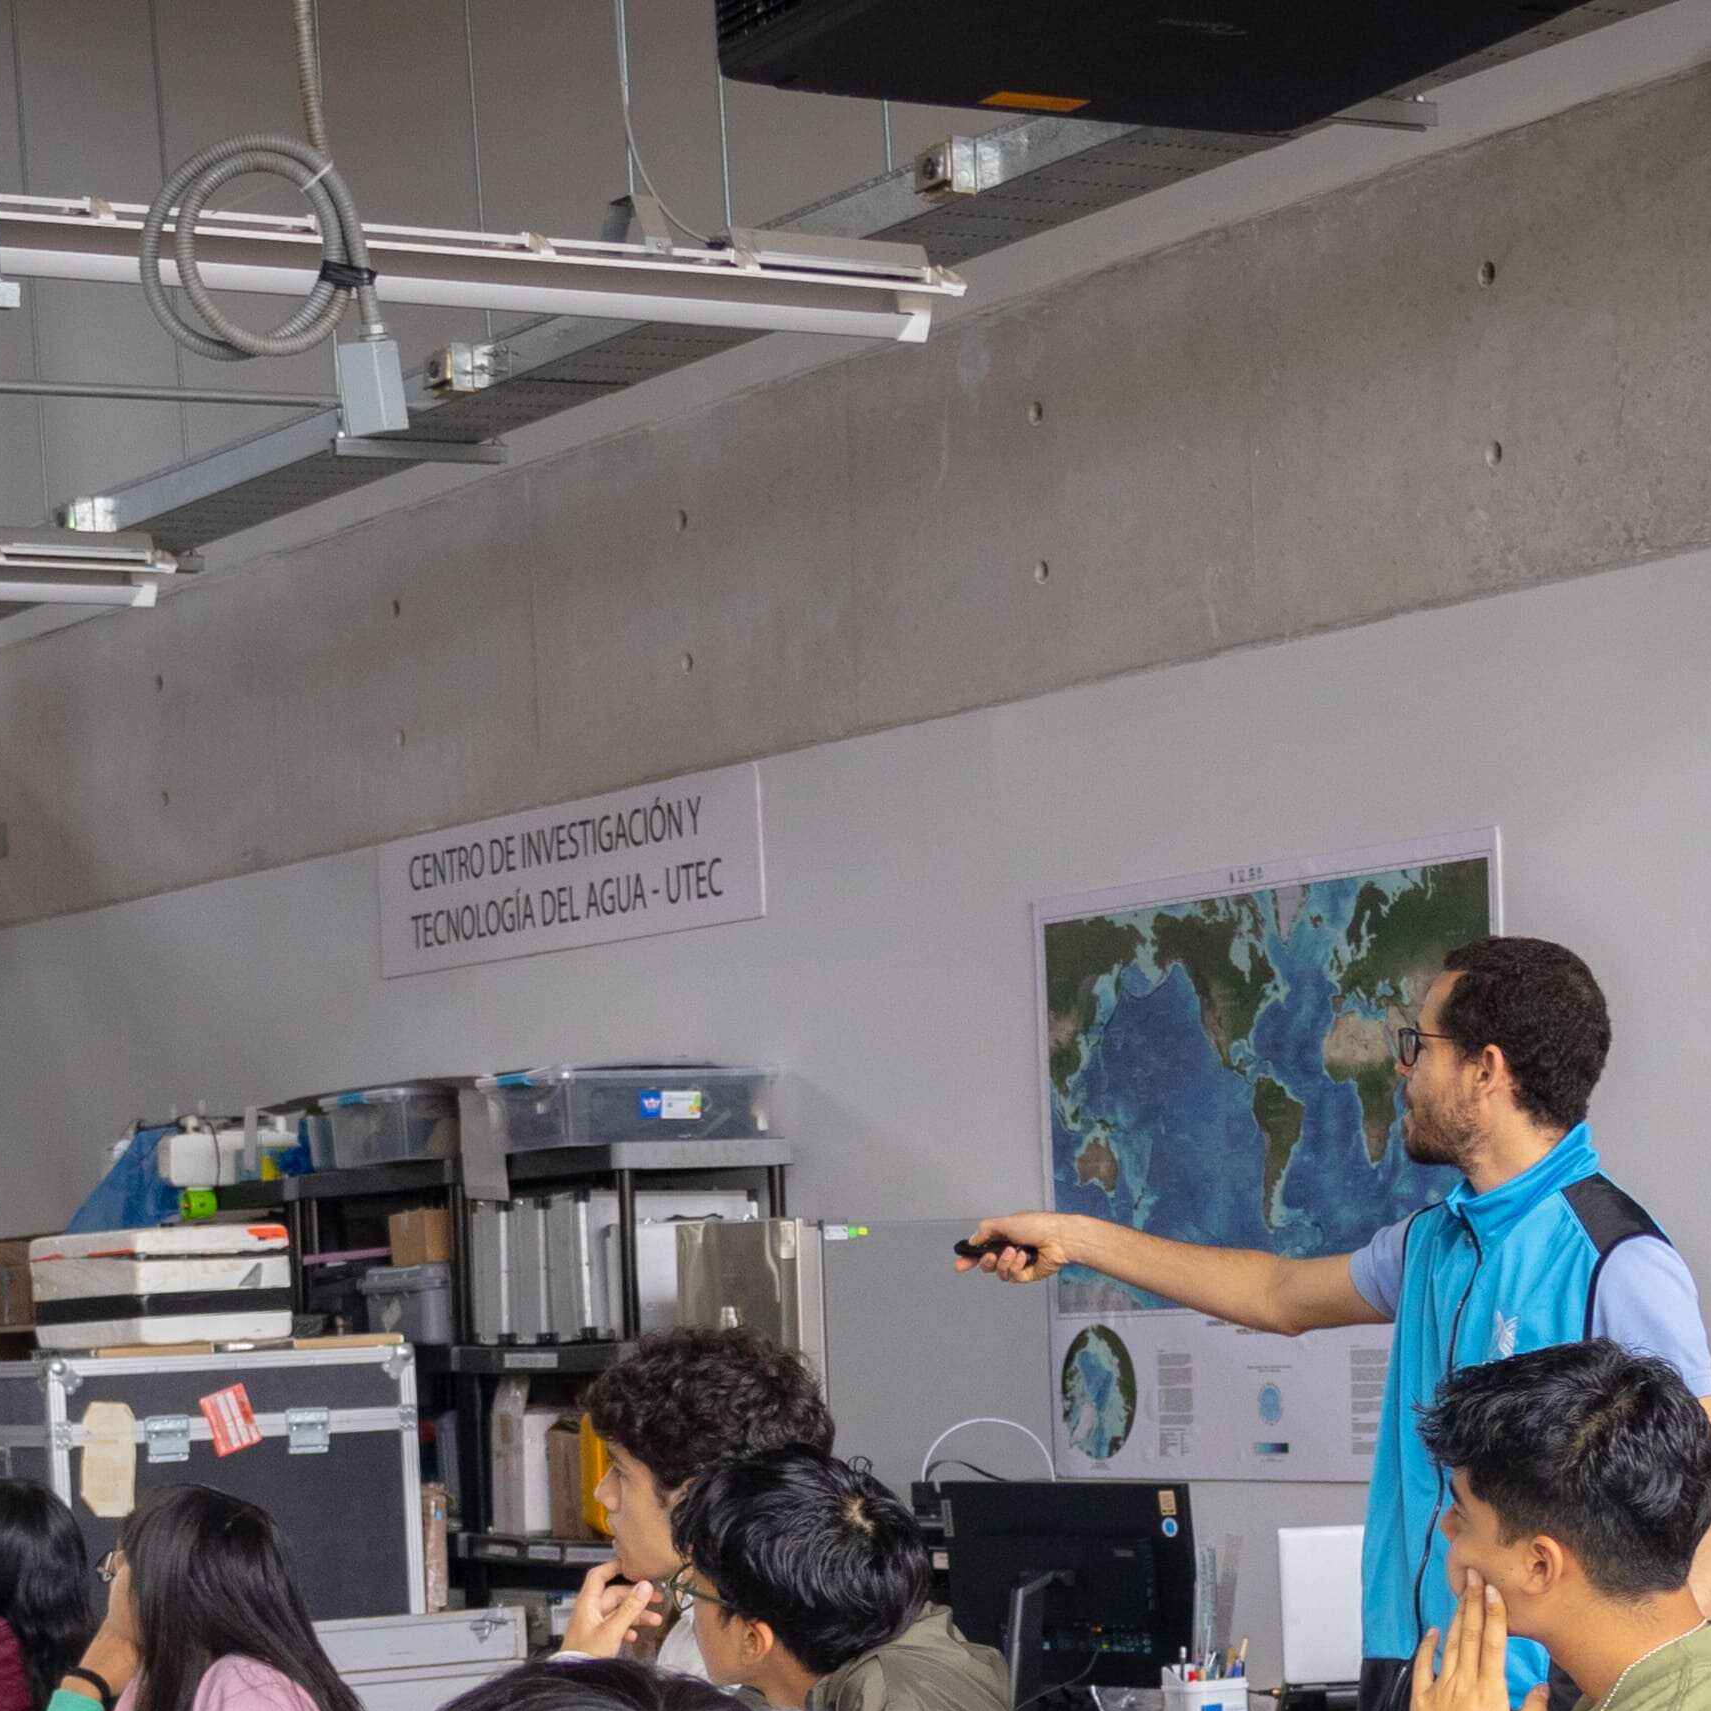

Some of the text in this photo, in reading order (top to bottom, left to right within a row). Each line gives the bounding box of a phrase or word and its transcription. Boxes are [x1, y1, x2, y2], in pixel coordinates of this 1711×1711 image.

[409, 796, 702, 891] CENTRO DE INVESTIGACIÓN Y
[411, 889, 536, 950] TECNOLOGÍA
[542, 886, 581, 928] DEL
[587, 873, 648, 920] AGUA
[666, 858, 724, 906] UTEC
